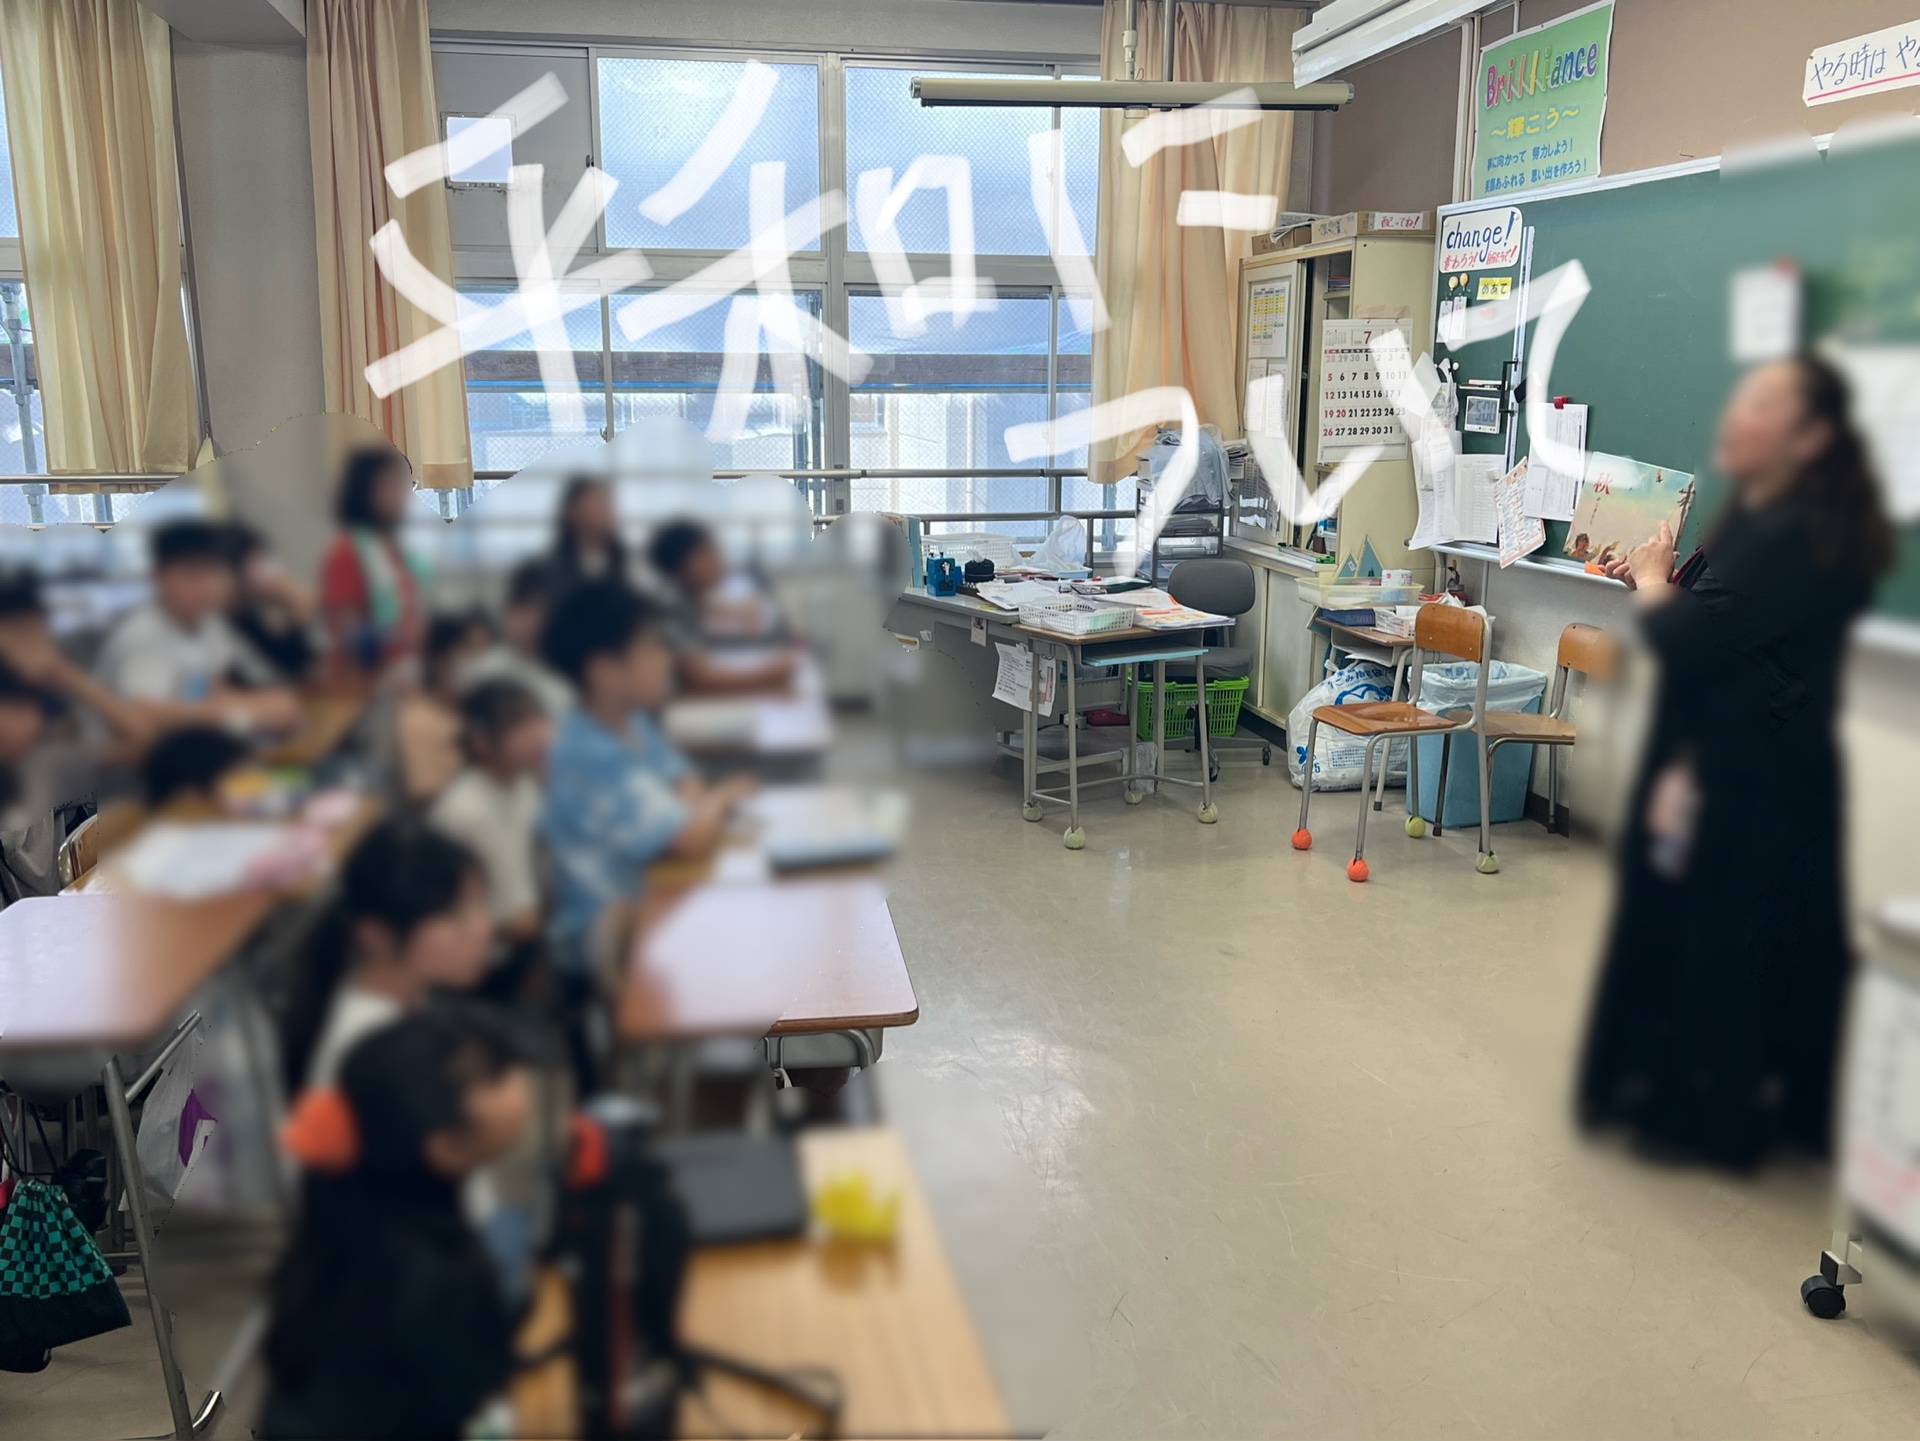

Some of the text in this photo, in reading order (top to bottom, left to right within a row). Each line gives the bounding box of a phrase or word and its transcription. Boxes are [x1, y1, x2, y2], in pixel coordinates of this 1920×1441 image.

[1810, 42, 1887, 91] やる時は
[1486, 42, 1598, 109] Brilliance
[1446, 210, 1517, 263] change!
[1481, 282, 1508, 295] めあて
[1363, 330, 1372, 345] 7
[1338, 354, 1348, 362] 29
[1350, 354, 1360, 362] 30
[1327, 371, 1407, 381] 5 6 7 8 9 10 11
[1325, 391, 1335, 400] 12
[1337, 391, 1347, 399] 13
[1349, 390, 1359, 399] 14
[1361, 390, 1371, 398] 15
[1373, 390, 1383, 398] 16
[1385, 390, 1395, 398] 17
[1324, 407, 1406, 418] 19 20 21 22 23 24 25
[1323, 428, 1333, 437] 26
[1335, 428, 1345, 436] 27
[1347, 427, 1358, 435] 28
[1360, 427, 1370, 435] 29
[1371, 427, 1382, 435] 30
[1383, 426, 1393, 434] 31
[1593, 471, 1614, 495] 秋
